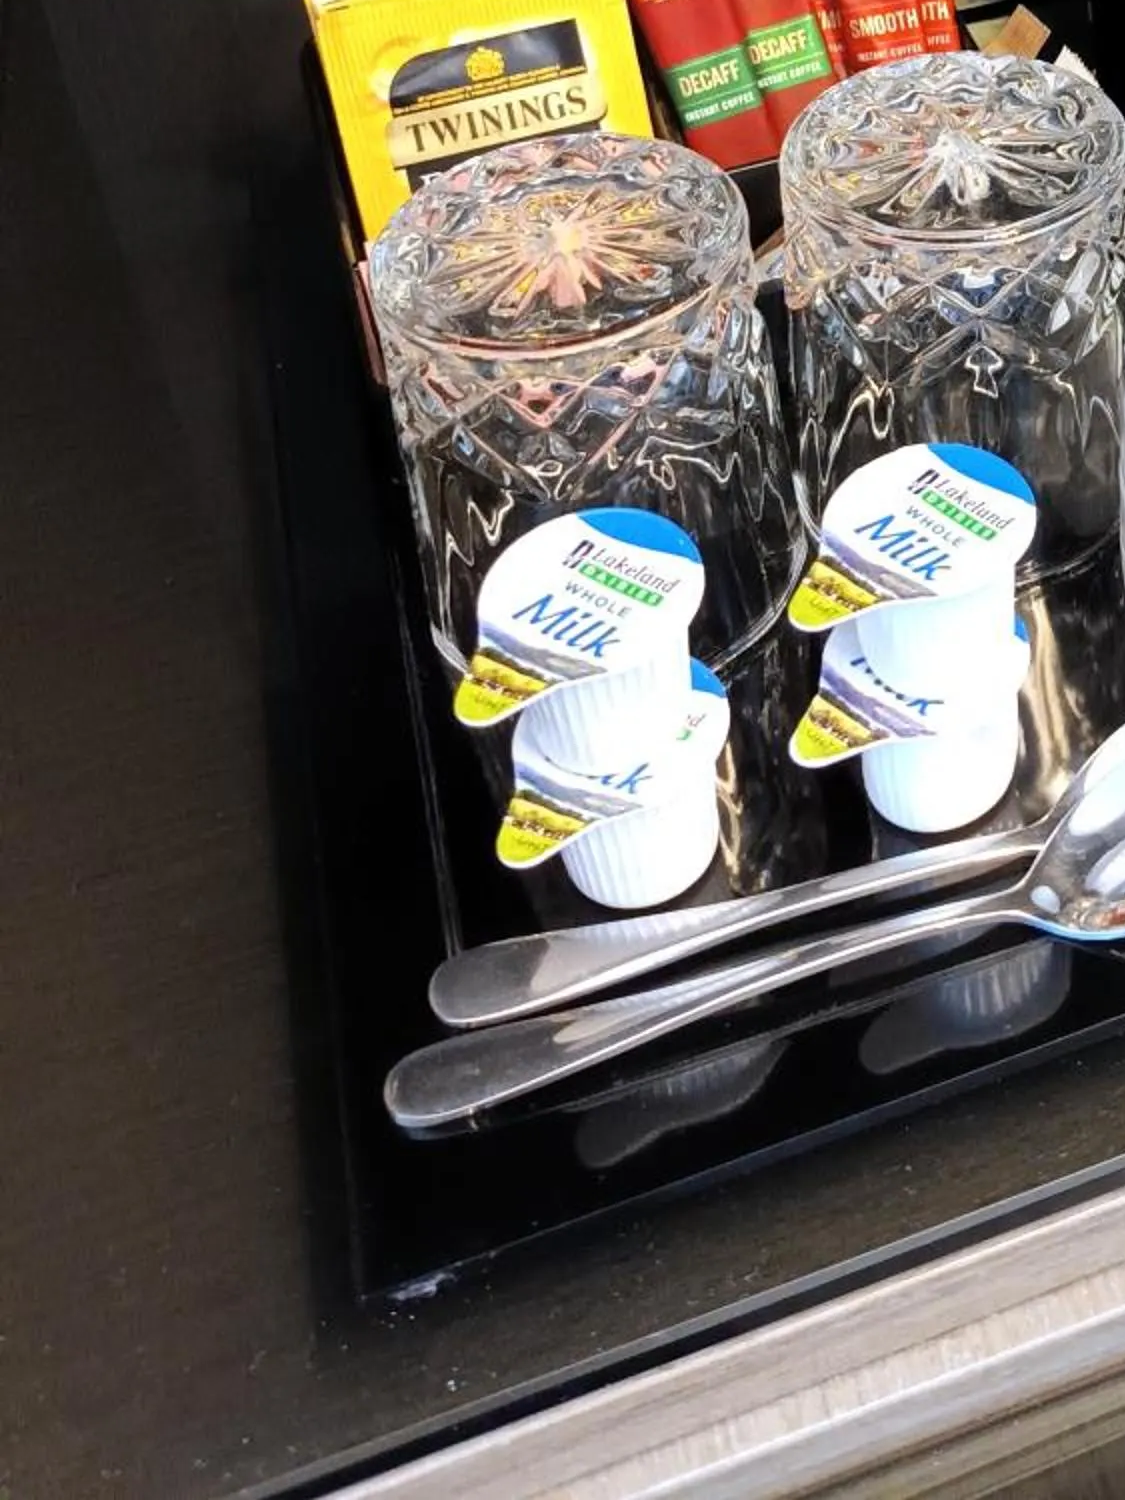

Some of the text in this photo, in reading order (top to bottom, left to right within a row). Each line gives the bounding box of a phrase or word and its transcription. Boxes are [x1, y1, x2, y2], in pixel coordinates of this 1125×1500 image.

[850, 7, 920, 39] SMOOTH
[749, 29, 809, 64] DECAFF
[678, 59, 740, 98] DECAFF
[789, 61, 822, 79] COFFEE
[406, 86, 588, 152] TWININGS
[684, 91, 755, 122] INSTANT COFFEE
[933, 478, 1017, 531] Lakeland
[855, 512, 953, 582] Milk
[906, 505, 967, 548] WHOLE
[591, 548, 682, 593] Lakeland
[565, 580, 633, 618] WHOLE
[512, 592, 622, 659] Milk
